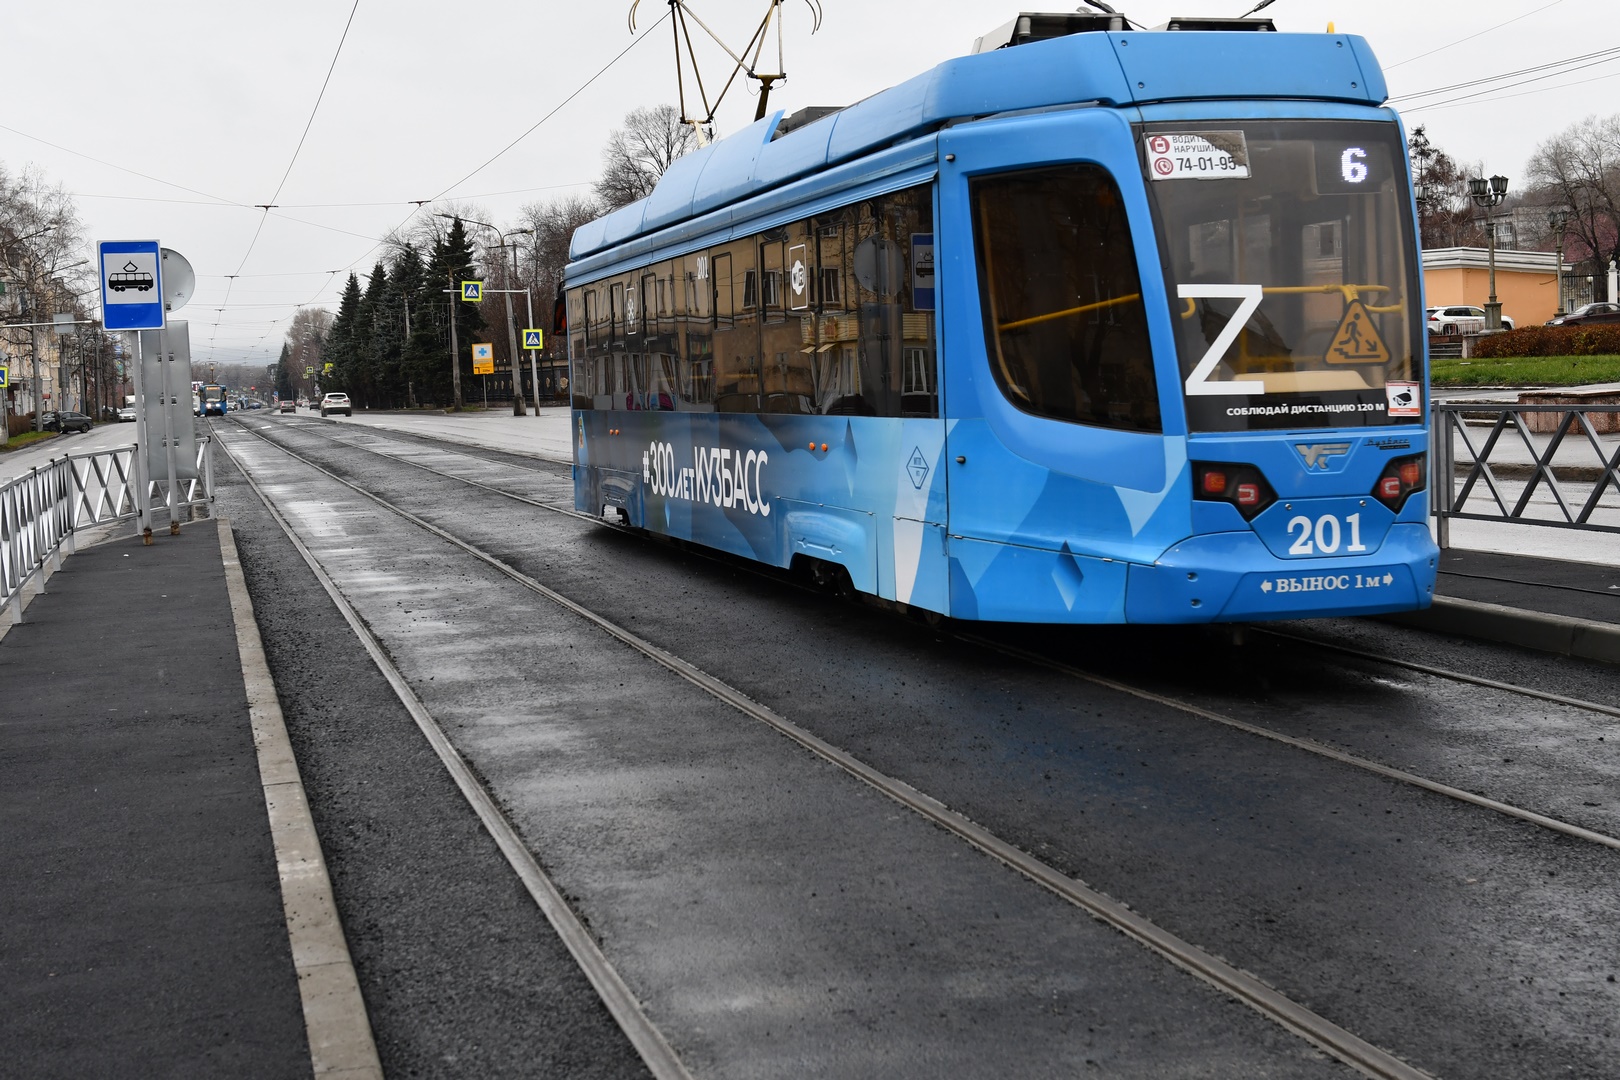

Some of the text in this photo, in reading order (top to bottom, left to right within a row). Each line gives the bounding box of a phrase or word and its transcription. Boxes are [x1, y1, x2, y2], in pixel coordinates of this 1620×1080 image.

[1176, 156, 1237, 171] 74-01-95
[1340, 147, 1368, 183] 6
[696, 256, 709, 280] 201
[1177, 283, 1265, 396] Z
[1226, 403, 1289, 416] СОБЛЮДАЙ
[1290, 403, 1356, 416] ДИСТАНЦИЮ
[1357, 403, 1375, 412] 120
[1286, 513, 1366, 556] 201
[1275, 575, 1350, 593] ВЫНОС
[1354, 574, 1363, 588] 1
